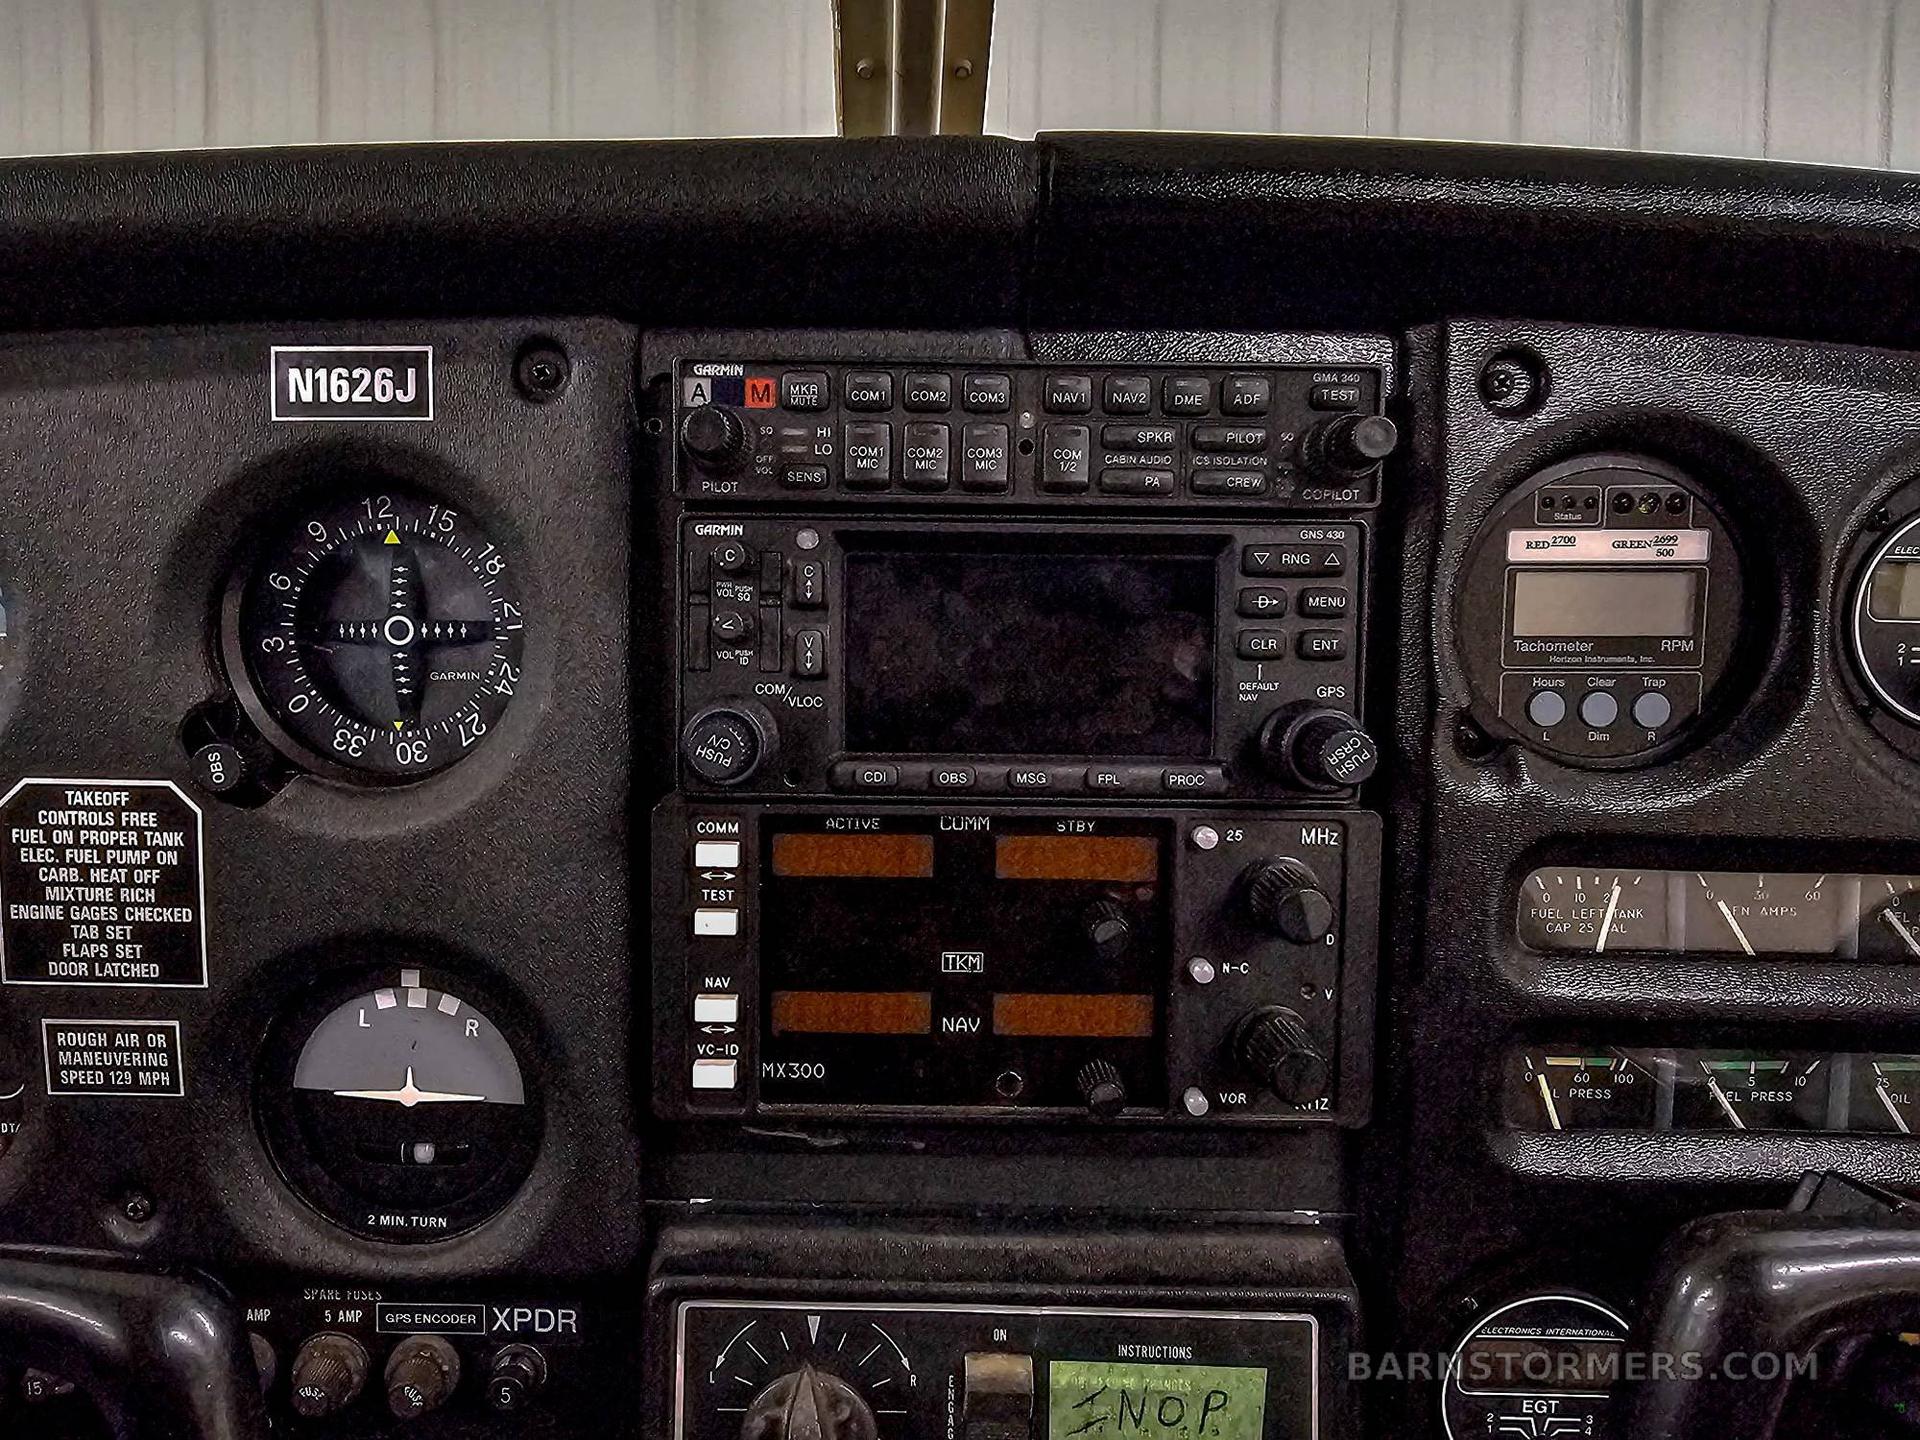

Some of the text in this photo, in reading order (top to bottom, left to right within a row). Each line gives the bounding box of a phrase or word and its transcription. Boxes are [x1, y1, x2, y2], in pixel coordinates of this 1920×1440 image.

[693, 364, 744, 376] GARMIN
[1313, 373, 1339, 383] GMA
[288, 367, 416, 402] N1626J
[790, 384, 818, 395] MKR
[751, 384, 771, 402] M
[851, 391, 886, 401] COM1
[911, 391, 946, 401] COM2
[970, 392, 1005, 402] COM3
[1053, 392, 1085, 403] NAV1
[1112, 393, 1147, 404] NAV2
[1322, 390, 1355, 400] TEST
[790, 397, 818, 406] MUTE
[1174, 395, 1202, 406] DME
[1233, 394, 1261, 405] ADF
[817, 427, 831, 438] HI
[1137, 432, 1173, 443] SPKR
[1226, 432, 1263, 443] PILOT
[814, 444, 833, 456] LO
[849, 447, 885, 457] COM1
[907, 448, 944, 458] COM2
[967, 448, 1003, 458] COM3
[1053, 449, 1082, 460] COM
[857, 458, 879, 469] MIC
[915, 460, 937, 470] MIC
[975, 460, 997, 470] MIC
[1105, 455, 1172, 465] CABIN AUDIO
[1059, 462, 1076, 472] 1/2
[787, 472, 822, 482] SENS
[1145, 477, 1161, 488] PA
[1226, 477, 1262, 488] CREW
[702, 482, 738, 493] PILOT
[1302, 489, 1360, 501] COPILOT
[362, 495, 392, 520] 12
[427, 504, 457, 531] 15
[1554, 512, 1582, 521] Status
[695, 525, 744, 536] GARMIN
[1300, 530, 1345, 540] GNS 430
[1525, 536, 1576, 550] RED 2700
[1612, 535, 1678, 549] GREEN 2699
[476, 541, 506, 575] 18
[1281, 553, 1311, 565] RNG
[1656, 549, 1675, 558] 500
[1308, 597, 1346, 607] MENU
[501, 601, 523, 631] 21
[1251, 639, 1277, 650] CLR
[1313, 639, 1339, 651] ENT
[1514, 640, 1593, 652] Tachometer
[1661, 640, 1694, 651] RPM
[1549, 655, 1582, 663] Horizon
[430, 671, 480, 681] GARMIN
[497, 660, 521, 697] 24
[1239, 682, 1279, 691] DEFAULT
[1532, 678, 1565, 687] Hours
[1587, 678, 1616, 687] Clear
[1642, 678, 1666, 689] Trap
[1239, 693, 1259, 702] NAV
[1316, 686, 1345, 698] GPS
[458, 712, 488, 748] 27
[332, 728, 367, 757] 33
[1588, 732, 1609, 741] Dim
[396, 740, 429, 764] 30
[695, 744, 733, 768] PUSH
[1326, 736, 1361, 766] CRSR
[207, 751, 226, 784] OBS
[1335, 749, 1372, 778] PUSH
[863, 770, 887, 783] CDI
[939, 771, 968, 785] OBS
[1016, 772, 1047, 785] MSG
[1098, 773, 1120, 786] FPL
[1169, 774, 1205, 787] PROC
[65, 791, 129, 806] TAKEOFF
[38, 810, 158, 827] CONTROLS FREE
[826, 818, 880, 830] ACTIVE
[940, 816, 990, 832] COMM
[696, 822, 739, 834] COMM
[1056, 820, 1096, 832] STBY
[12, 828, 185, 847] FUEL ON PROPER TANK
[1226, 830, 1243, 842] 25
[1301, 828, 1339, 846] MHz
[20, 848, 177, 865] ELEC. FUEL PUMP ON
[39, 868, 160, 884] CARB. HEAT OFF
[45, 887, 156, 903] MIXTURE RICH
[702, 890, 735, 901] TEST
[10, 905, 192, 922] ENGINE GAGES CHECKED
[1531, 908, 1644, 918] FUEL LEFT TANK
[1760, 906, 1797, 916] AMPS
[71, 925, 133, 940] TAB SET
[1546, 923, 1572, 933] CAP
[63, 944, 143, 959] FLAPS SET
[945, 954, 980, 970] TKM
[48, 962, 160, 978] DOOR LATCHED
[1222, 963, 1249, 974] N-C
[704, 976, 730, 988] NAV
[942, 1016, 980, 1033] NAV
[57, 1032, 167, 1048] ROUGH AIR OR
[696, 1044, 739, 1056] VC-ID
[59, 1052, 168, 1067] MANEUVERING
[762, 1062, 826, 1079] MX300
[61, 1071, 170, 1086] SPEED 129 MPH
[1574, 1073, 1590, 1083] 60
[1614, 1073, 1634, 1084] 100
[1219, 1093, 1247, 1104] VOR
[1569, 1088, 1612, 1099] PRESS
[1751, 1091, 1793, 1101] PRESS
[367, 1215, 447, 1228] 2 MIN. TURN
[303, 1287, 341, 1300] SPARE
[325, 1310, 363, 1323] 5 AMP
[386, 1313, 476, 1325] GPS ENCODER
[492, 1306, 577, 1333] XPDR
[993, 1328, 1007, 1341] ON
[1482, 1327, 1614, 1337] ELECTRONICS INTERNATIONAL
[1118, 1345, 1193, 1360] INSTRUCTIONS
[1522, 1400, 1559, 1414] EGT
